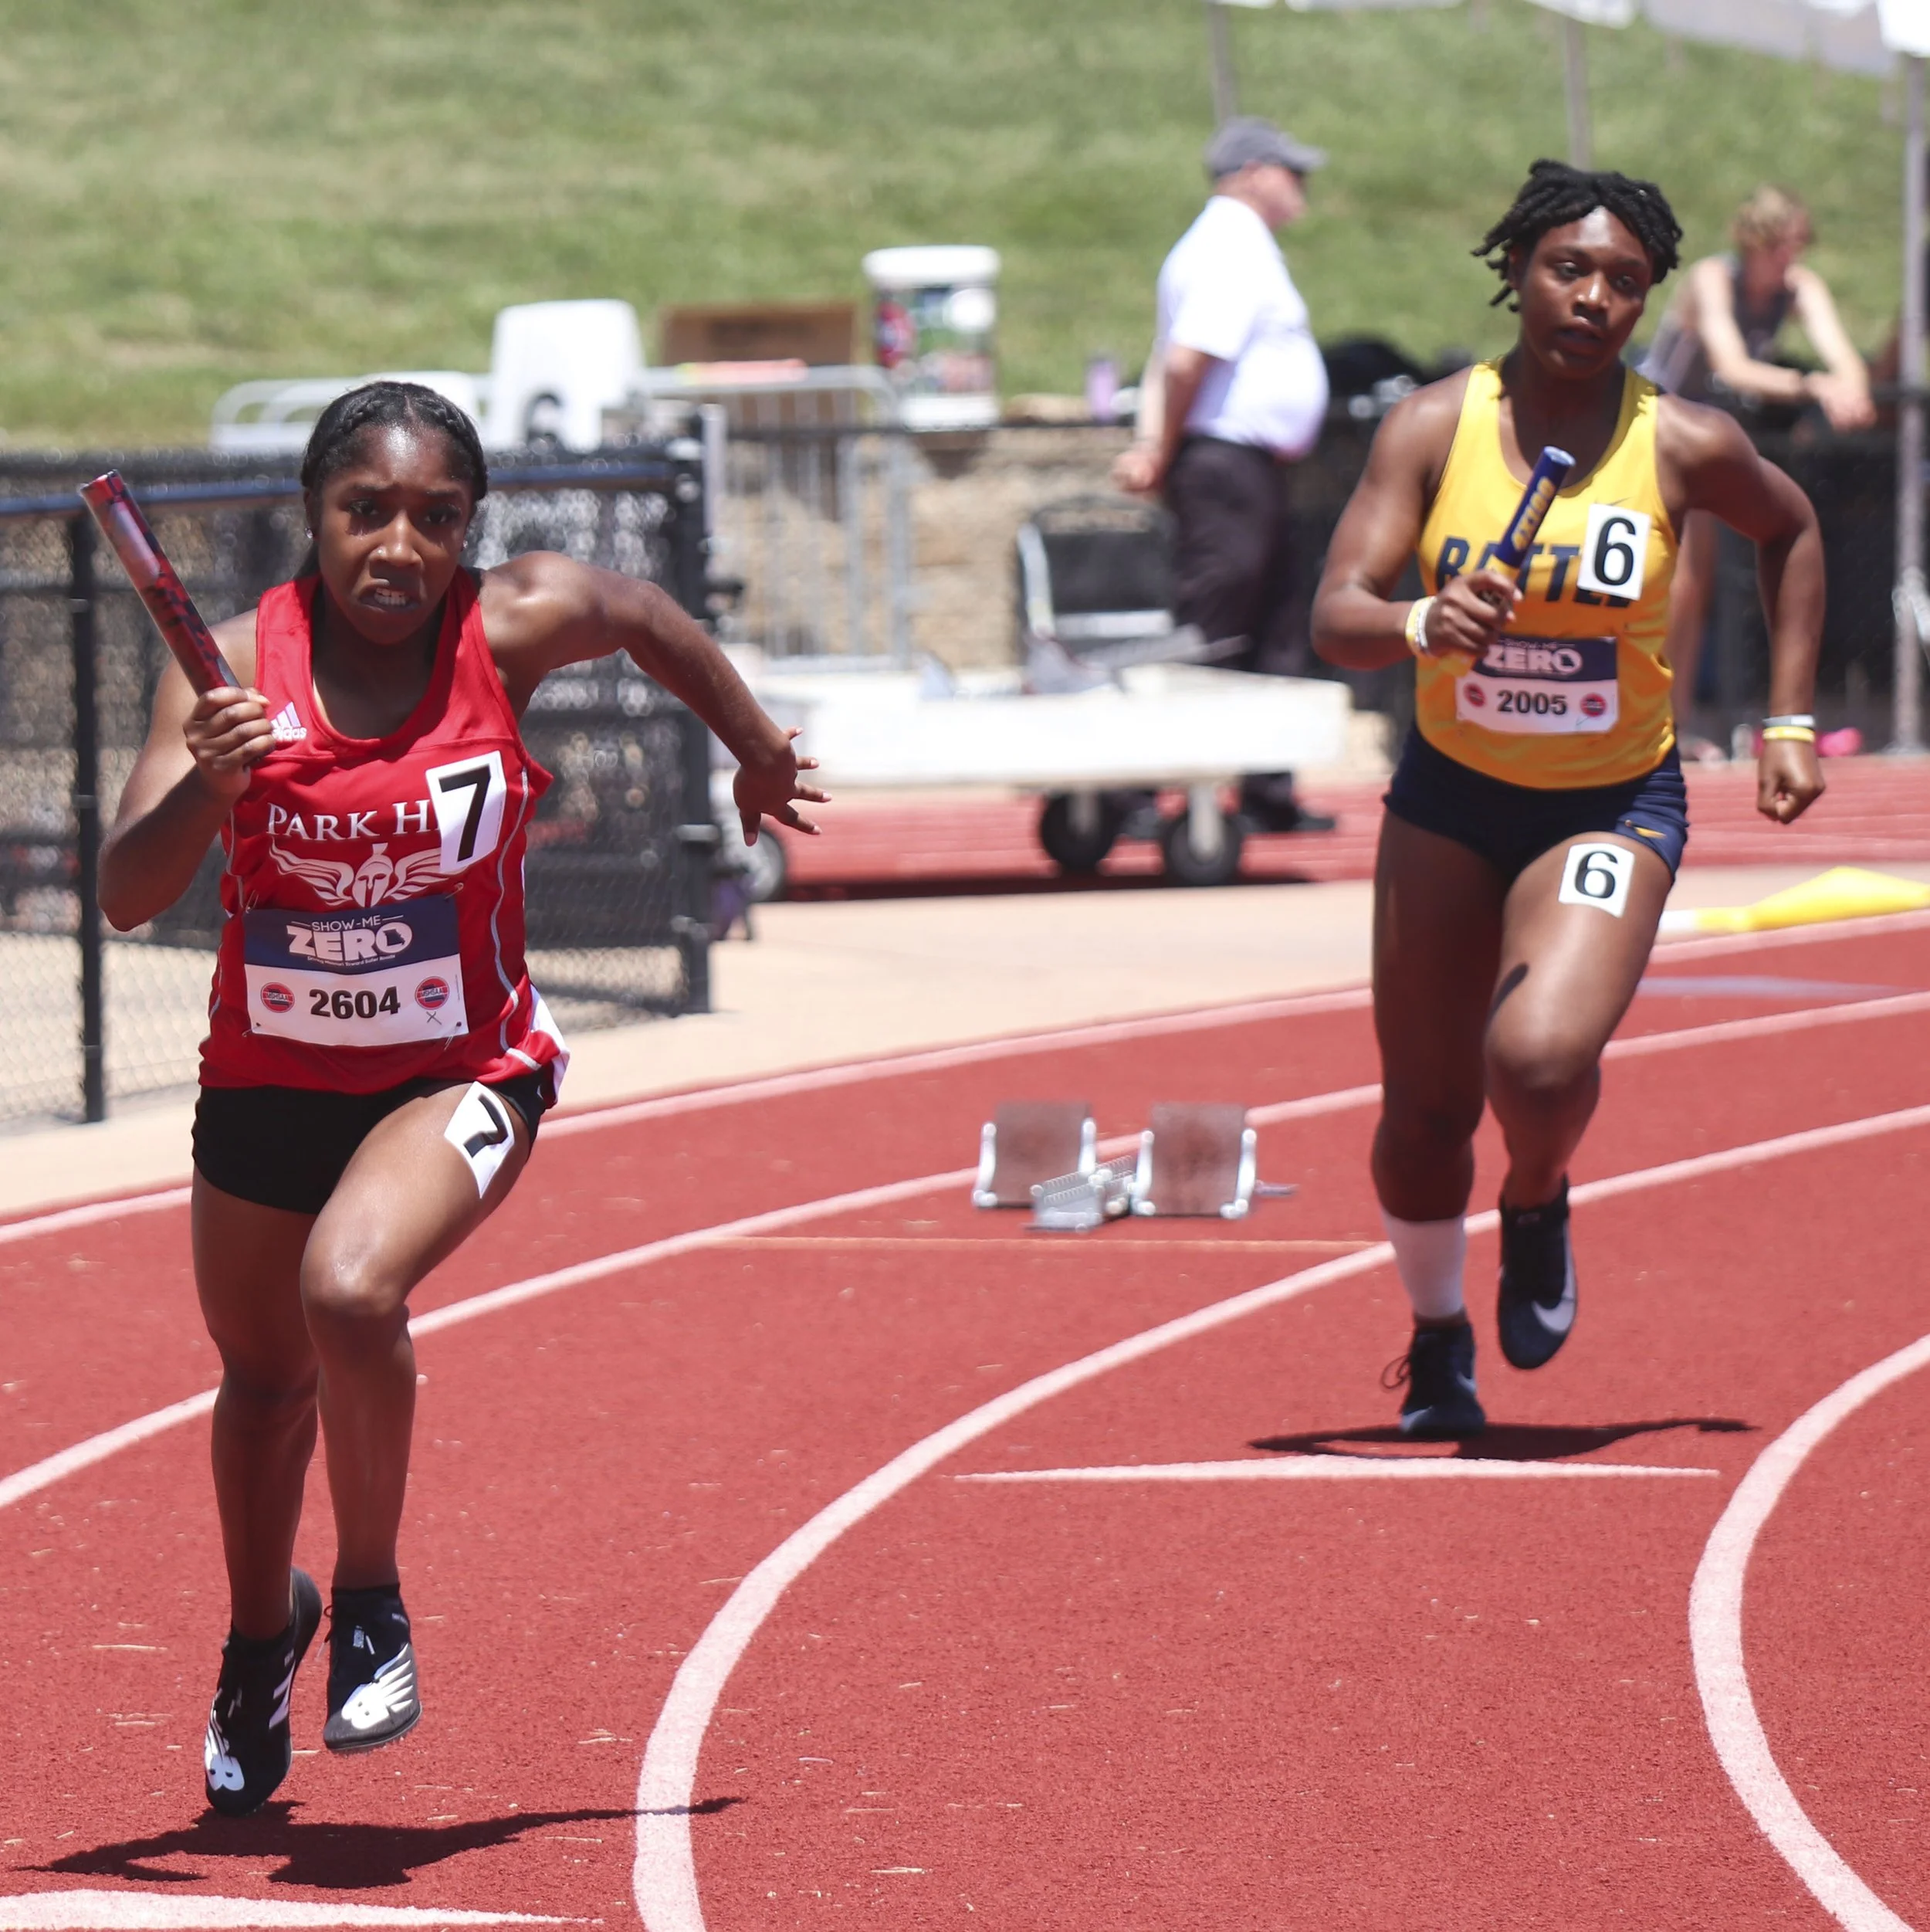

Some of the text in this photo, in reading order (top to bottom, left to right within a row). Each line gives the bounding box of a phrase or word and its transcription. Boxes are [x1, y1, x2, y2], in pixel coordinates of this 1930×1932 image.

[1594, 517, 1636, 586] 6
[1482, 644, 1582, 673] ZERO
[1497, 690, 1567, 715] 2005
[266, 802, 381, 841] PARK
[438, 763, 492, 862] 7
[1575, 851, 1618, 899] 6
[286, 922, 413, 961] ZERO
[312, 915, 381, 932] SHOW-ME
[309, 985, 401, 1019] 2604
[463, 1093, 509, 1158] 7
